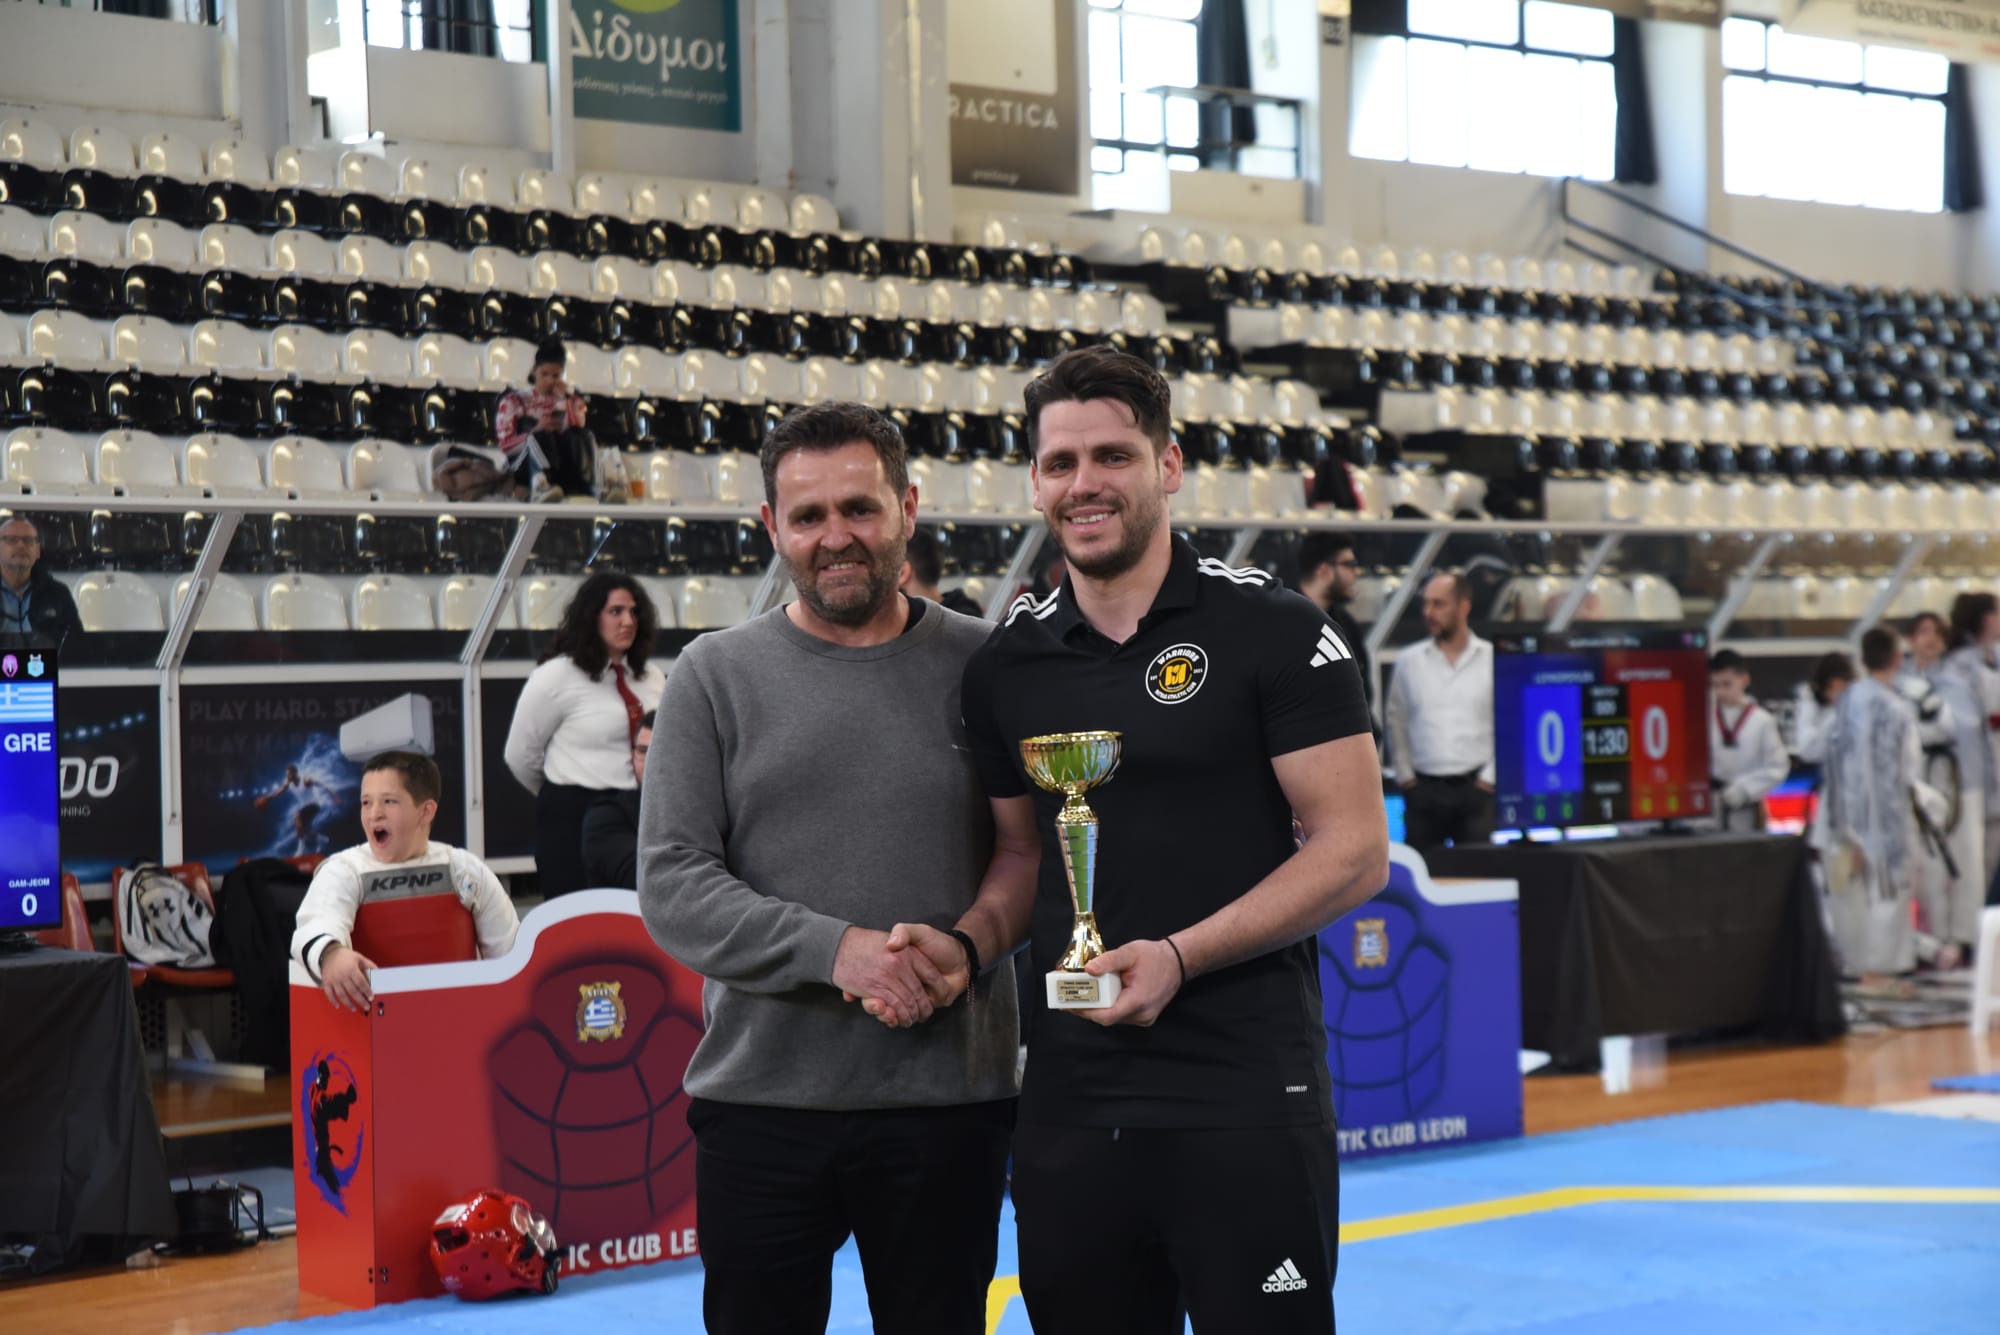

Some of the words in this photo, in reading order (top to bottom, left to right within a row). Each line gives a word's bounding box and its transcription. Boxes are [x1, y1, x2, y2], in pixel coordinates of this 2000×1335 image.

[948, 96, 1058, 129] RACTICA
[1157, 648, 1200, 665] WARRIORS
[190, 700, 248, 720] PLAY
[4, 733, 51, 752] GRE
[1538, 710, 1565, 767] 0
[1584, 726, 1628, 756] 1:30
[1643, 705, 1669, 760] 0
[60, 756, 119, 799] DO
[61, 805, 90, 817] NING
[9, 878, 50, 888] GAM-JEOM
[371, 872, 443, 892] KPNP
[22, 893, 37, 916] 0
[1337, 1128, 1367, 1153] TIC
[1371, 1122, 1416, 1148] CLUB
[1420, 1115, 1467, 1142] LEON
[563, 1243, 591, 1272] IC
[600, 1234, 661, 1264] CLUB
[670, 1228, 697, 1255] LE
[1262, 1278, 1307, 1293] adidas
